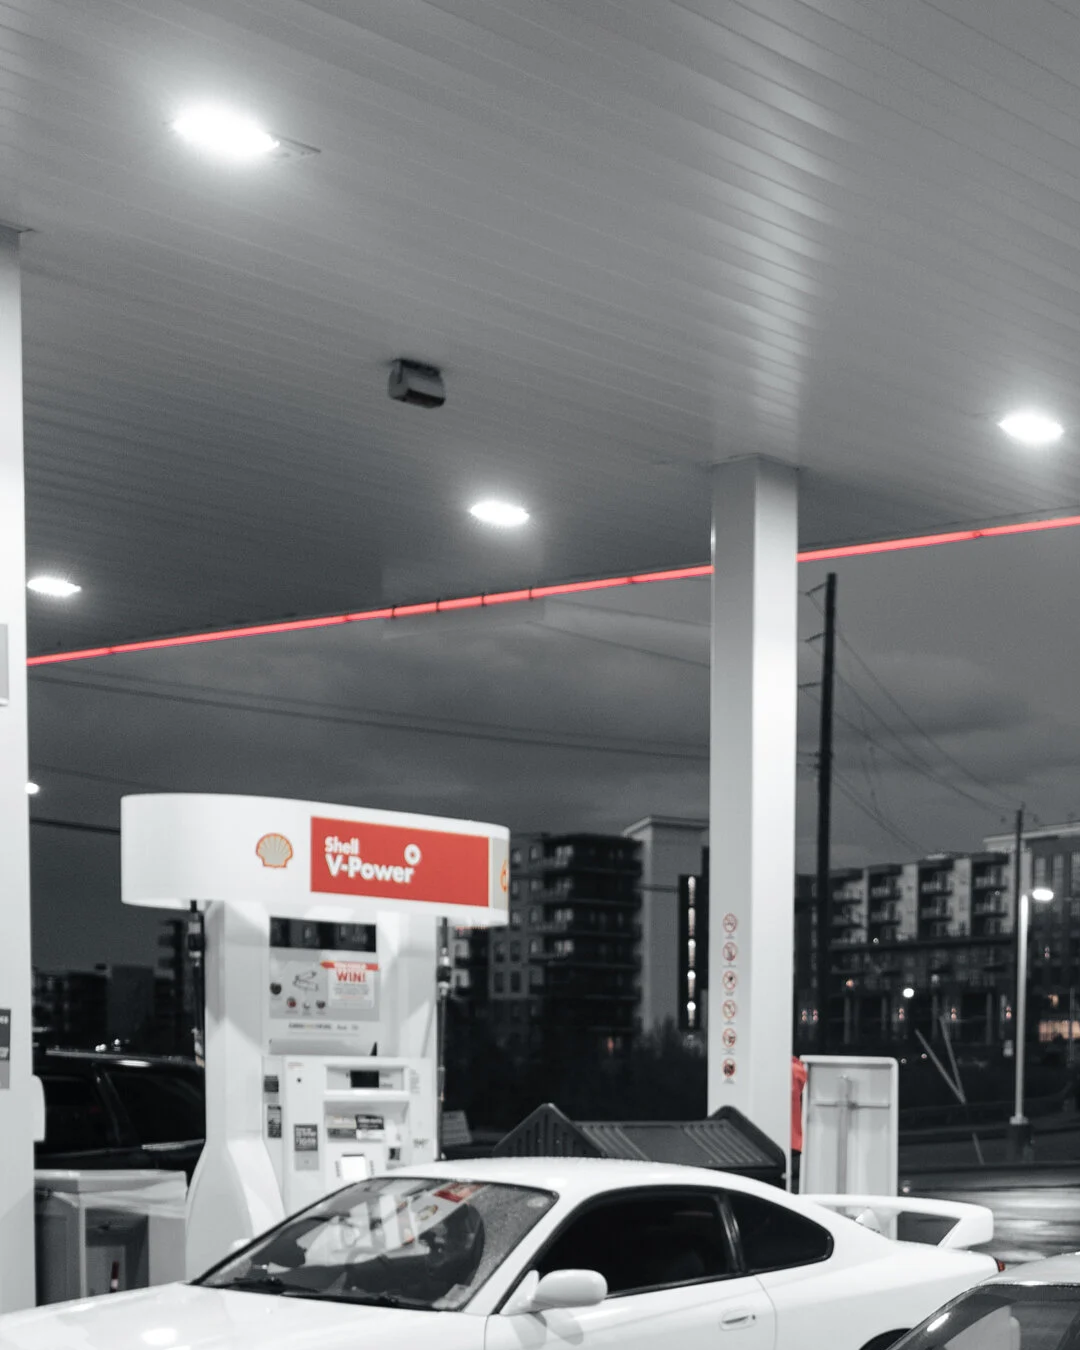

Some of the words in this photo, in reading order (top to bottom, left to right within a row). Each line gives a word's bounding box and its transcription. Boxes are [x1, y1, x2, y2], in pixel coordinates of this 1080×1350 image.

[324, 835, 360, 855] Shell
[325, 853, 415, 884] V-Power
[336, 970, 367, 983] WIN!
